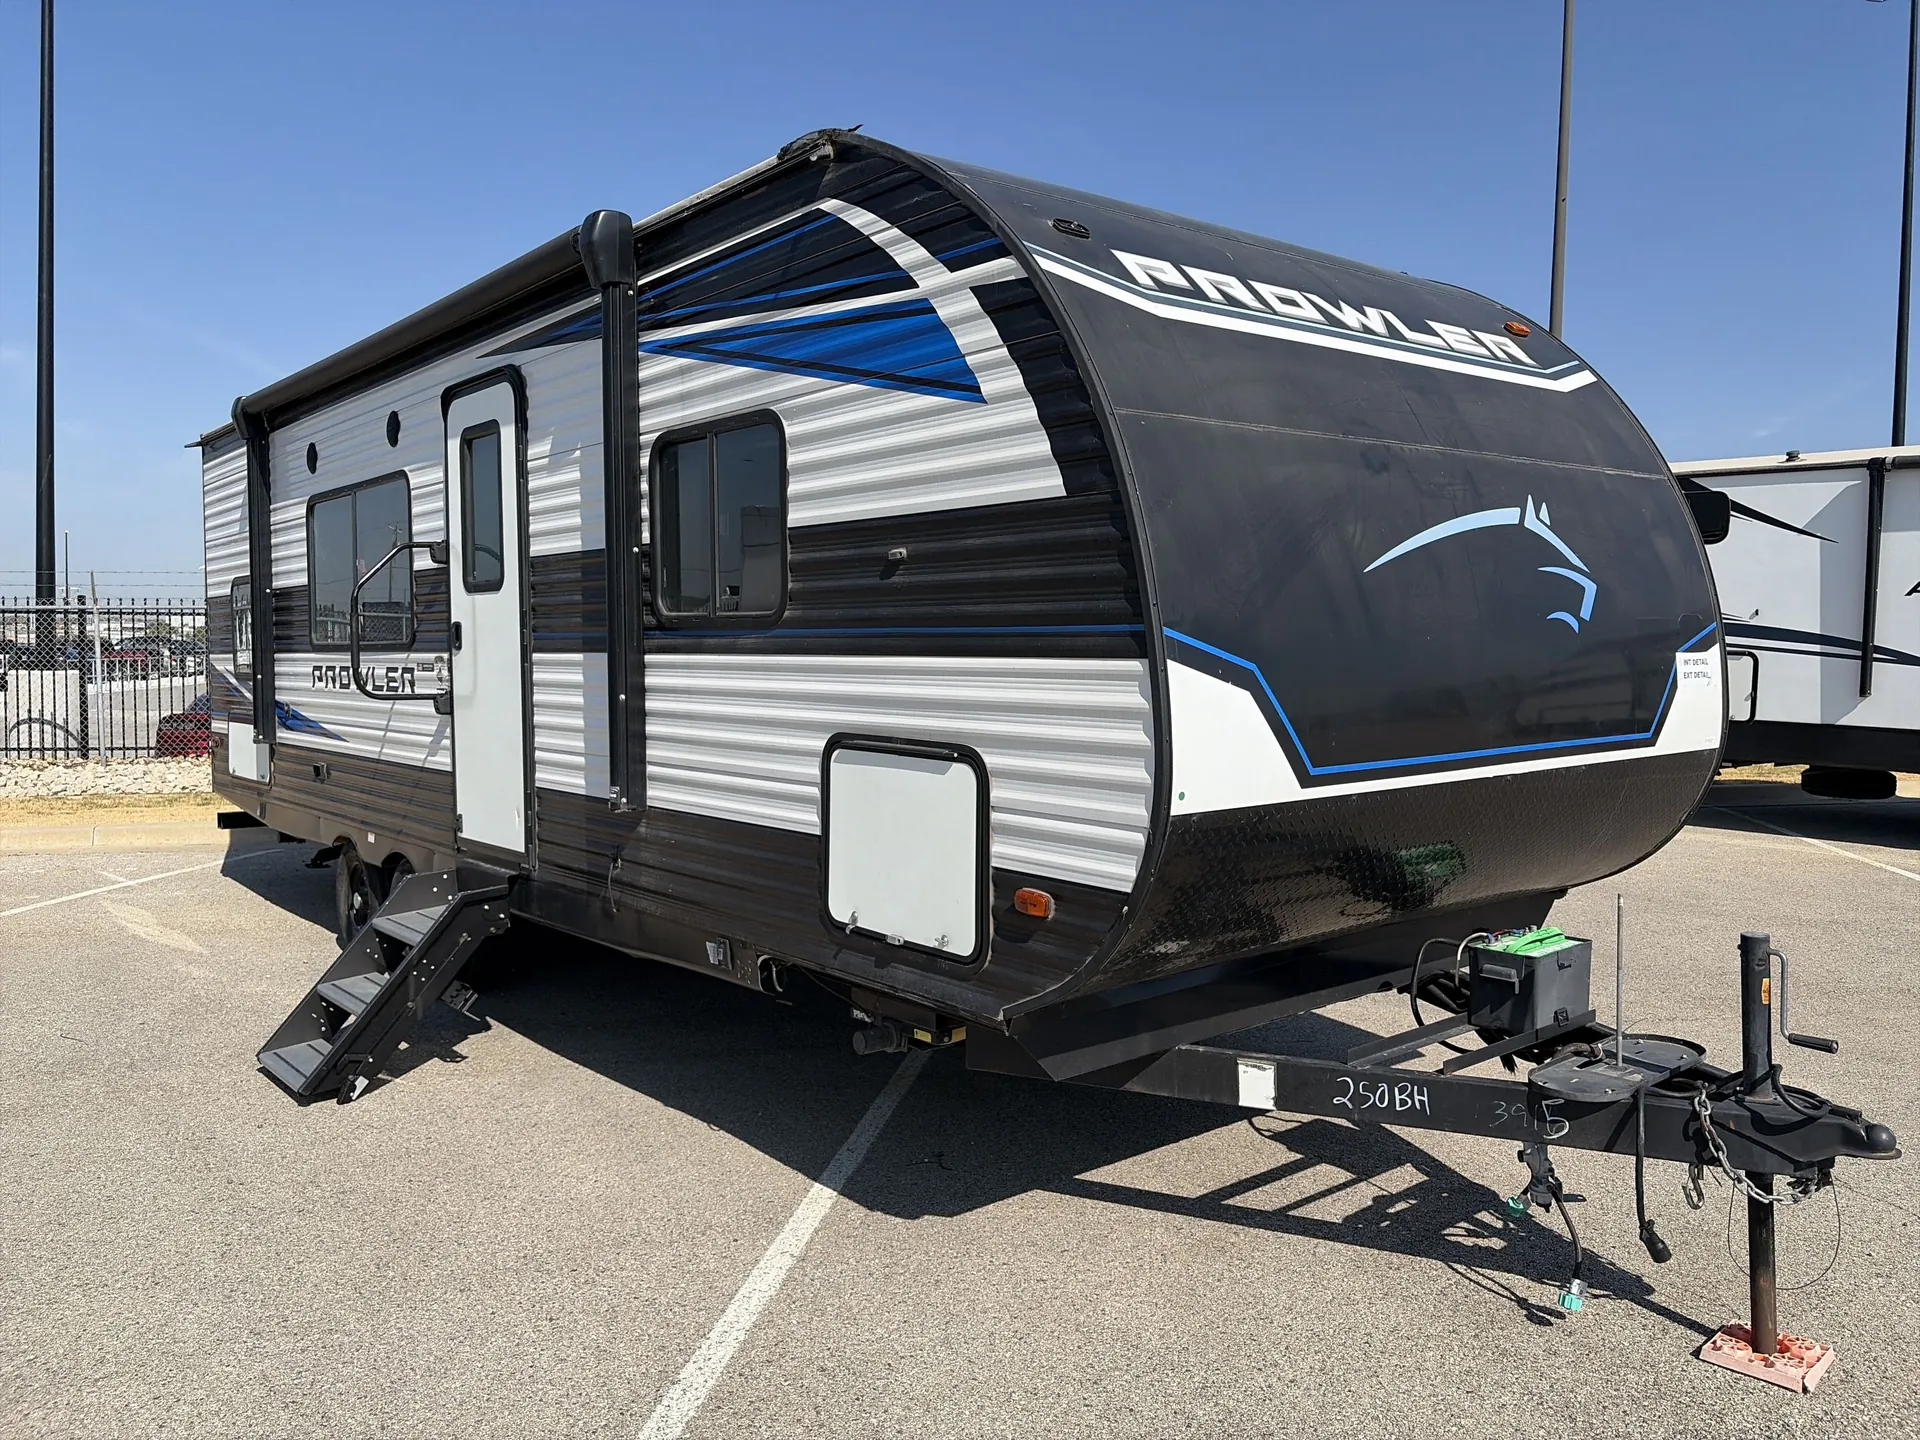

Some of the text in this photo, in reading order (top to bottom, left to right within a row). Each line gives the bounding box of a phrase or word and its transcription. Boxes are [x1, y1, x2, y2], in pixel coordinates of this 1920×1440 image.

[1109, 249, 1538, 367] PROWLER
[1683, 658, 1708, 666] INT DETAIL
[1683, 671, 1711, 679] EXT DETAIL
[1332, 1076, 1430, 1116] 250BH
